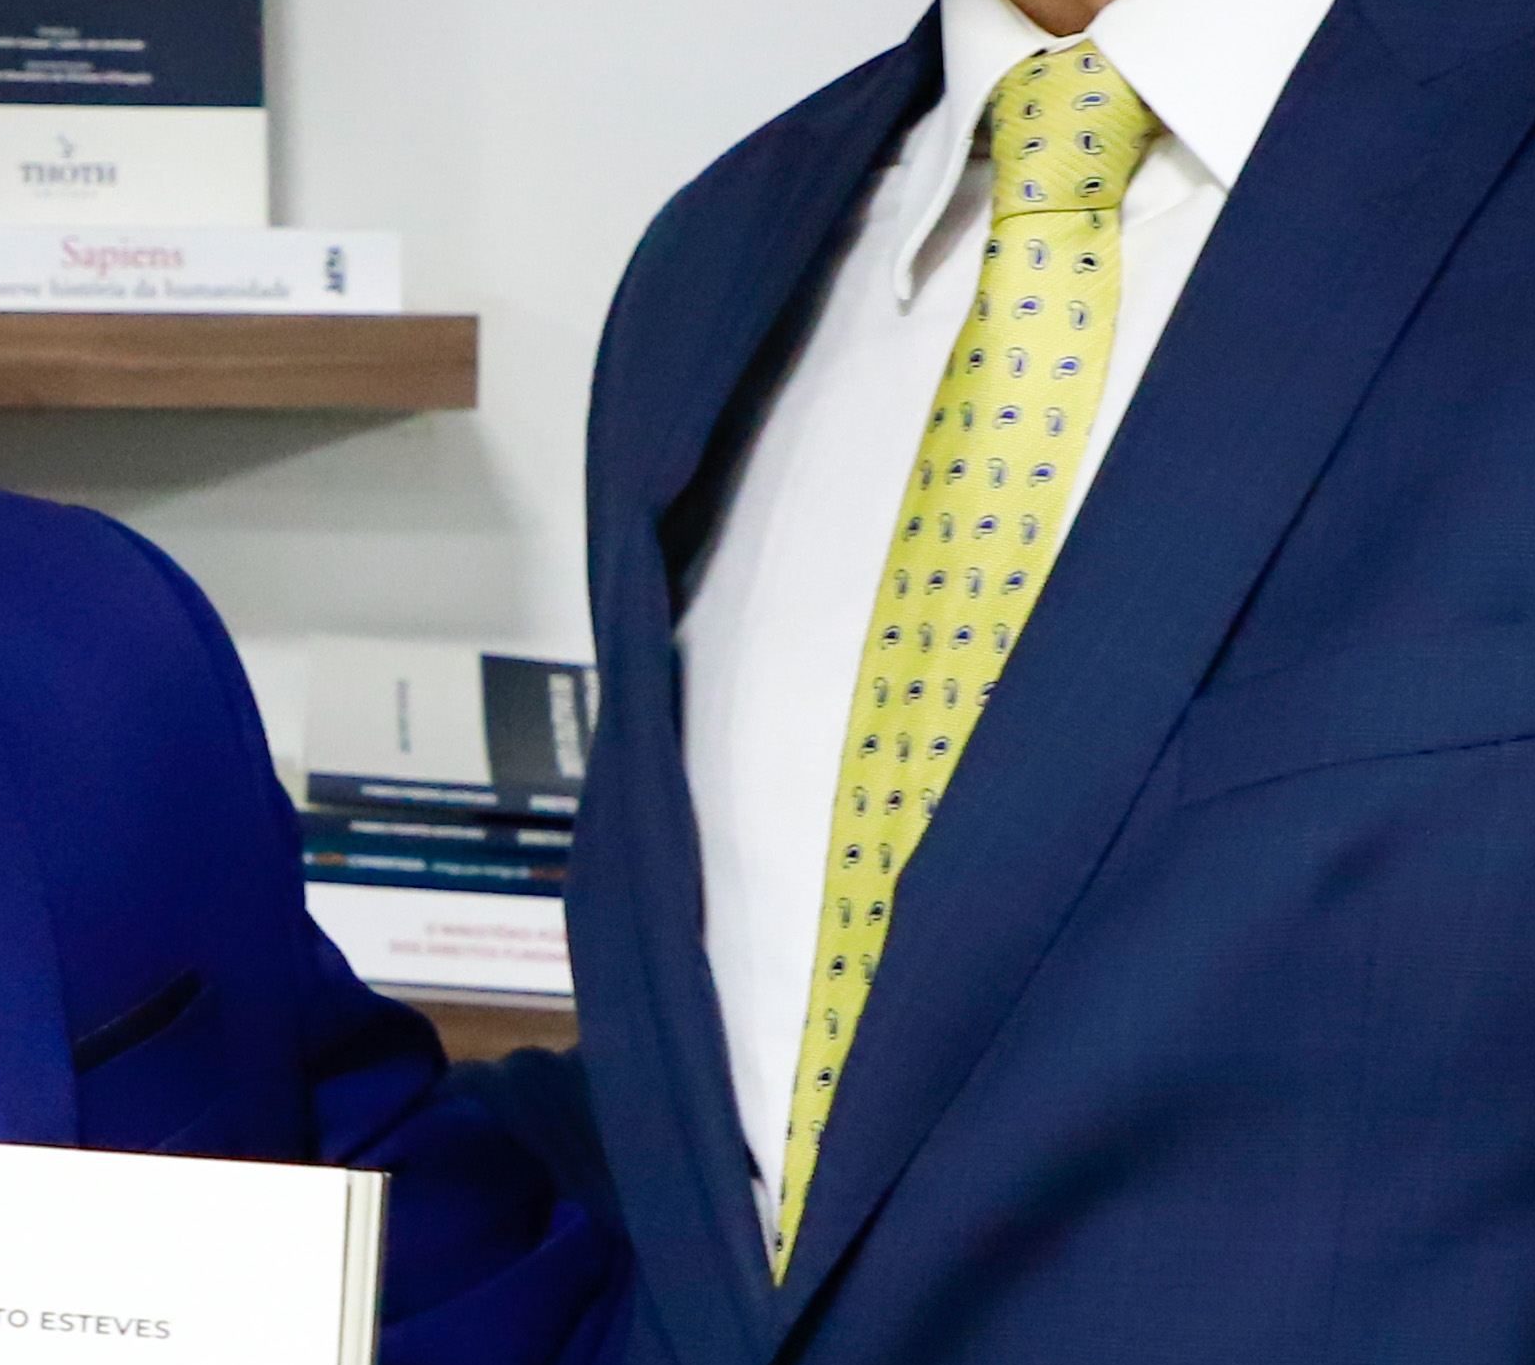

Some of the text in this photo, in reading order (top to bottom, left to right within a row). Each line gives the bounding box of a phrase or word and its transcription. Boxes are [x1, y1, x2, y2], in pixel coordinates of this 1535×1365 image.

[20, 160, 117, 187] THOTH
[60, 236, 183, 276] Sapiens
[40, 1311, 171, 1340] ESTEVES
